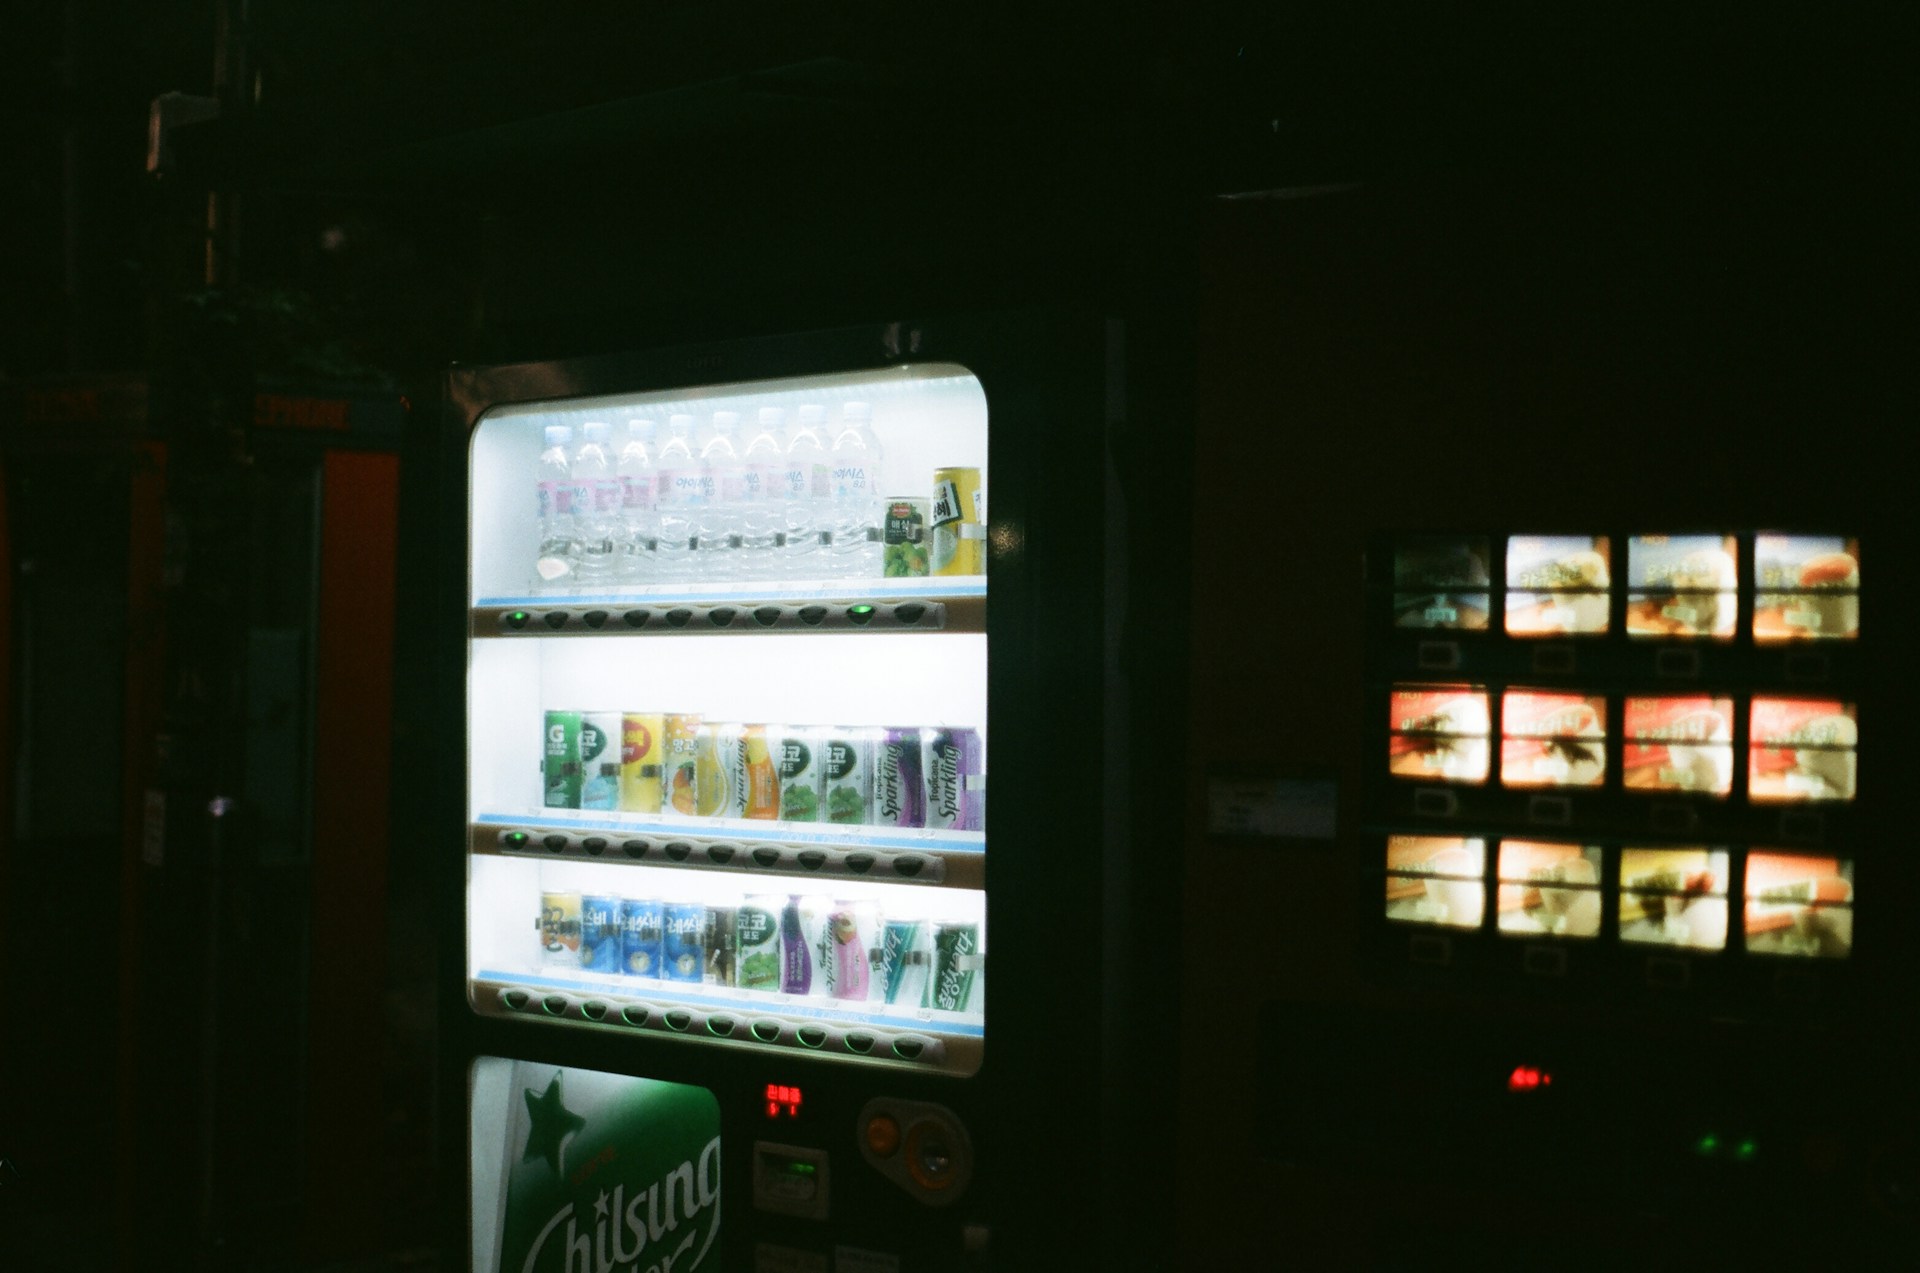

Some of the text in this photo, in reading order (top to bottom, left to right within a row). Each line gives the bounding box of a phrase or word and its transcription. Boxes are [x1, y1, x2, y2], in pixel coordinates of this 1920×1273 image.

[549, 725, 564, 743] G
[881, 744, 902, 821] Sparkling
[938, 745, 962, 821] Sparkling
[738, 914, 767, 930] 코코
